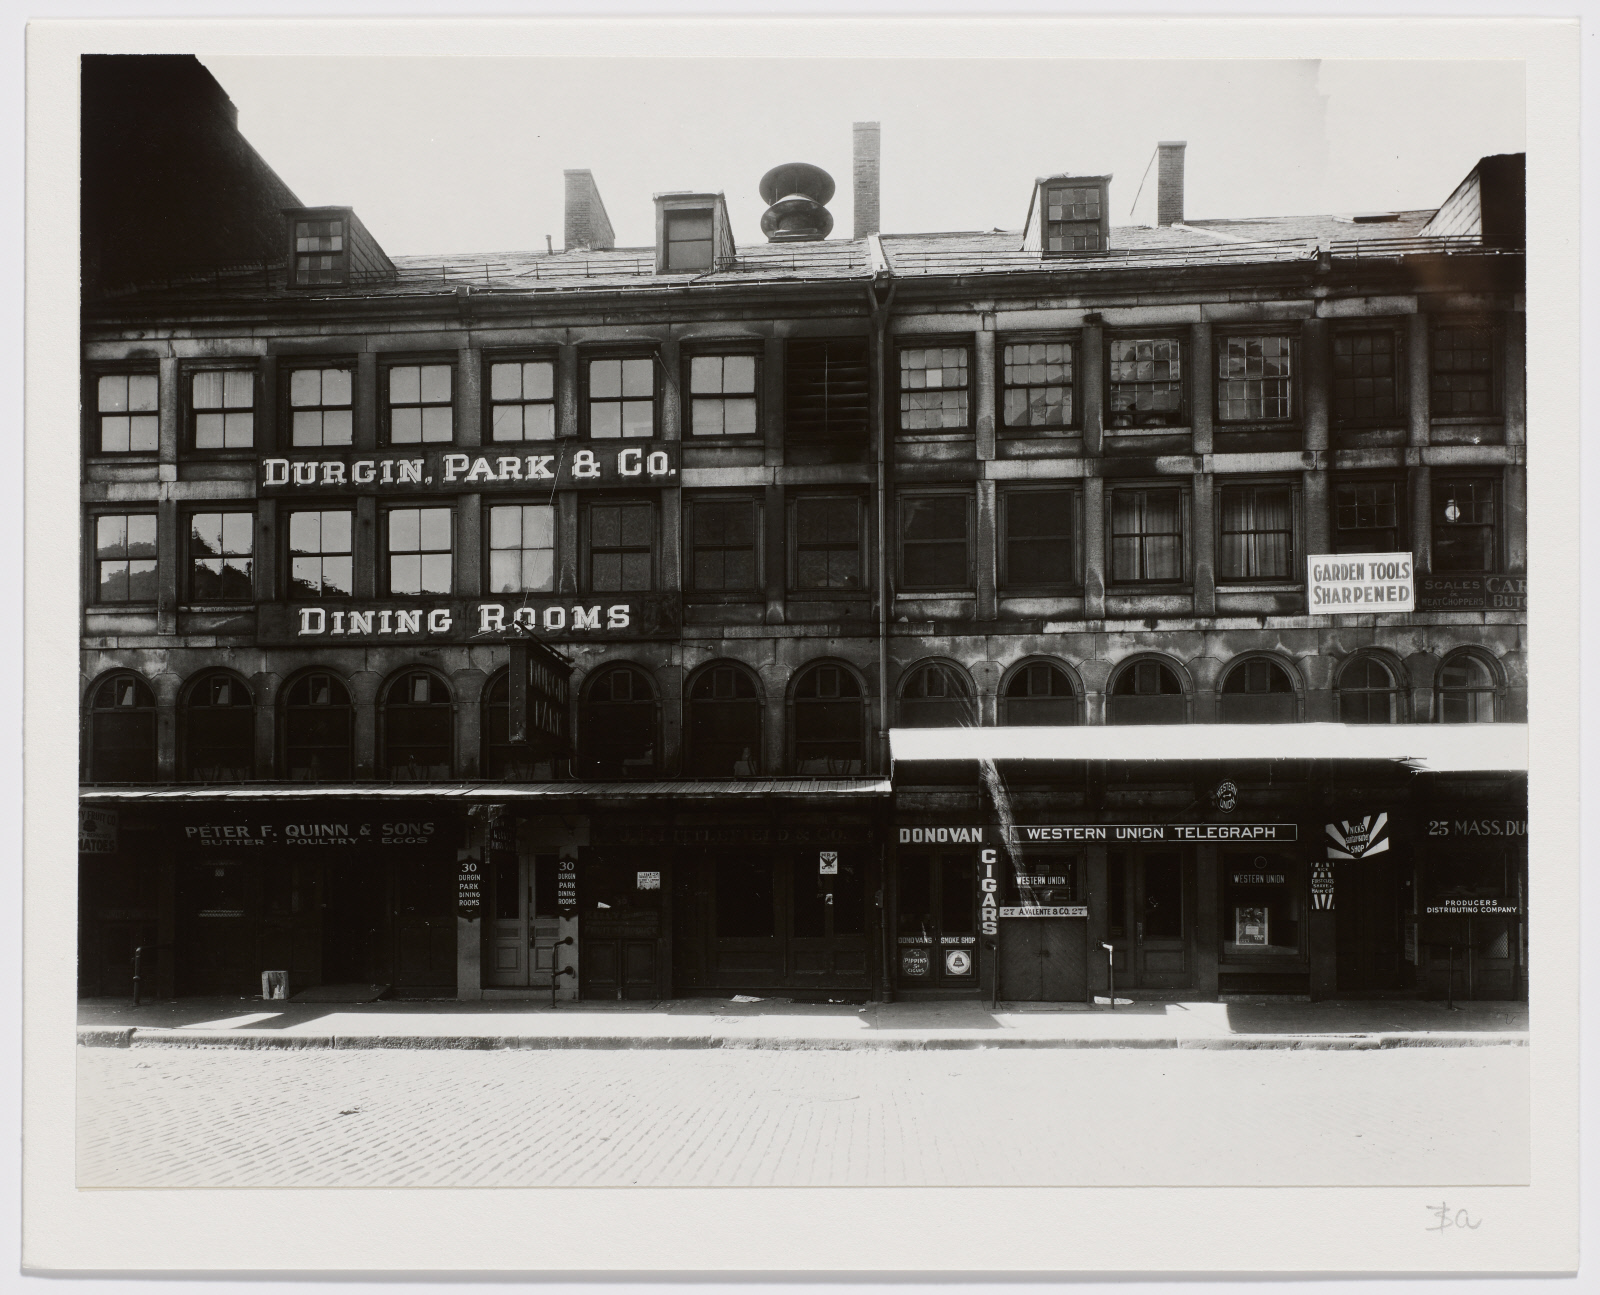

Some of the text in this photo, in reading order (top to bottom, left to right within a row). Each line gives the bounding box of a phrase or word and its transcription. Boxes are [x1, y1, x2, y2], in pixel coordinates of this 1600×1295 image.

[262, 457, 433, 488] DURGIN,
[442, 453, 555, 482] PARK
[571, 449, 601, 479] &
[1313, 561, 1410, 582] GARDEN TOOLS
[1424, 580, 1481, 590] SCALES
[1313, 585, 1410, 605] SHARPENED
[297, 604, 631, 636] DINING ROOMS
[1216, 782, 1238, 798] WESTERN
[1219, 797, 1236, 809] UNION
[87, 811, 106, 823] FRUIT
[185, 822, 435, 838] PETER F. QUINN & SONS
[1026, 827, 1276, 840] WESTERN UNION TELEGRAPH
[1428, 820, 1449, 836] 25
[900, 828, 983, 843] DONOVAN
[286, 838, 358, 846] POULTRY
[1350, 844, 1365, 854] SHOP
[461, 863, 478, 873] 30
[559, 861, 575, 871] 30
[1016, 876, 1066, 885] WESTERN UNION
[1233, 874, 1285, 884] WESTERN UNION
[981, 849, 998, 935] CIGARS
[558, 898, 577, 906] ROOMS
[1003, 908, 1015, 916] 27
[1071, 907, 1084, 916] 27
[940, 936, 960, 944] SMOKE
